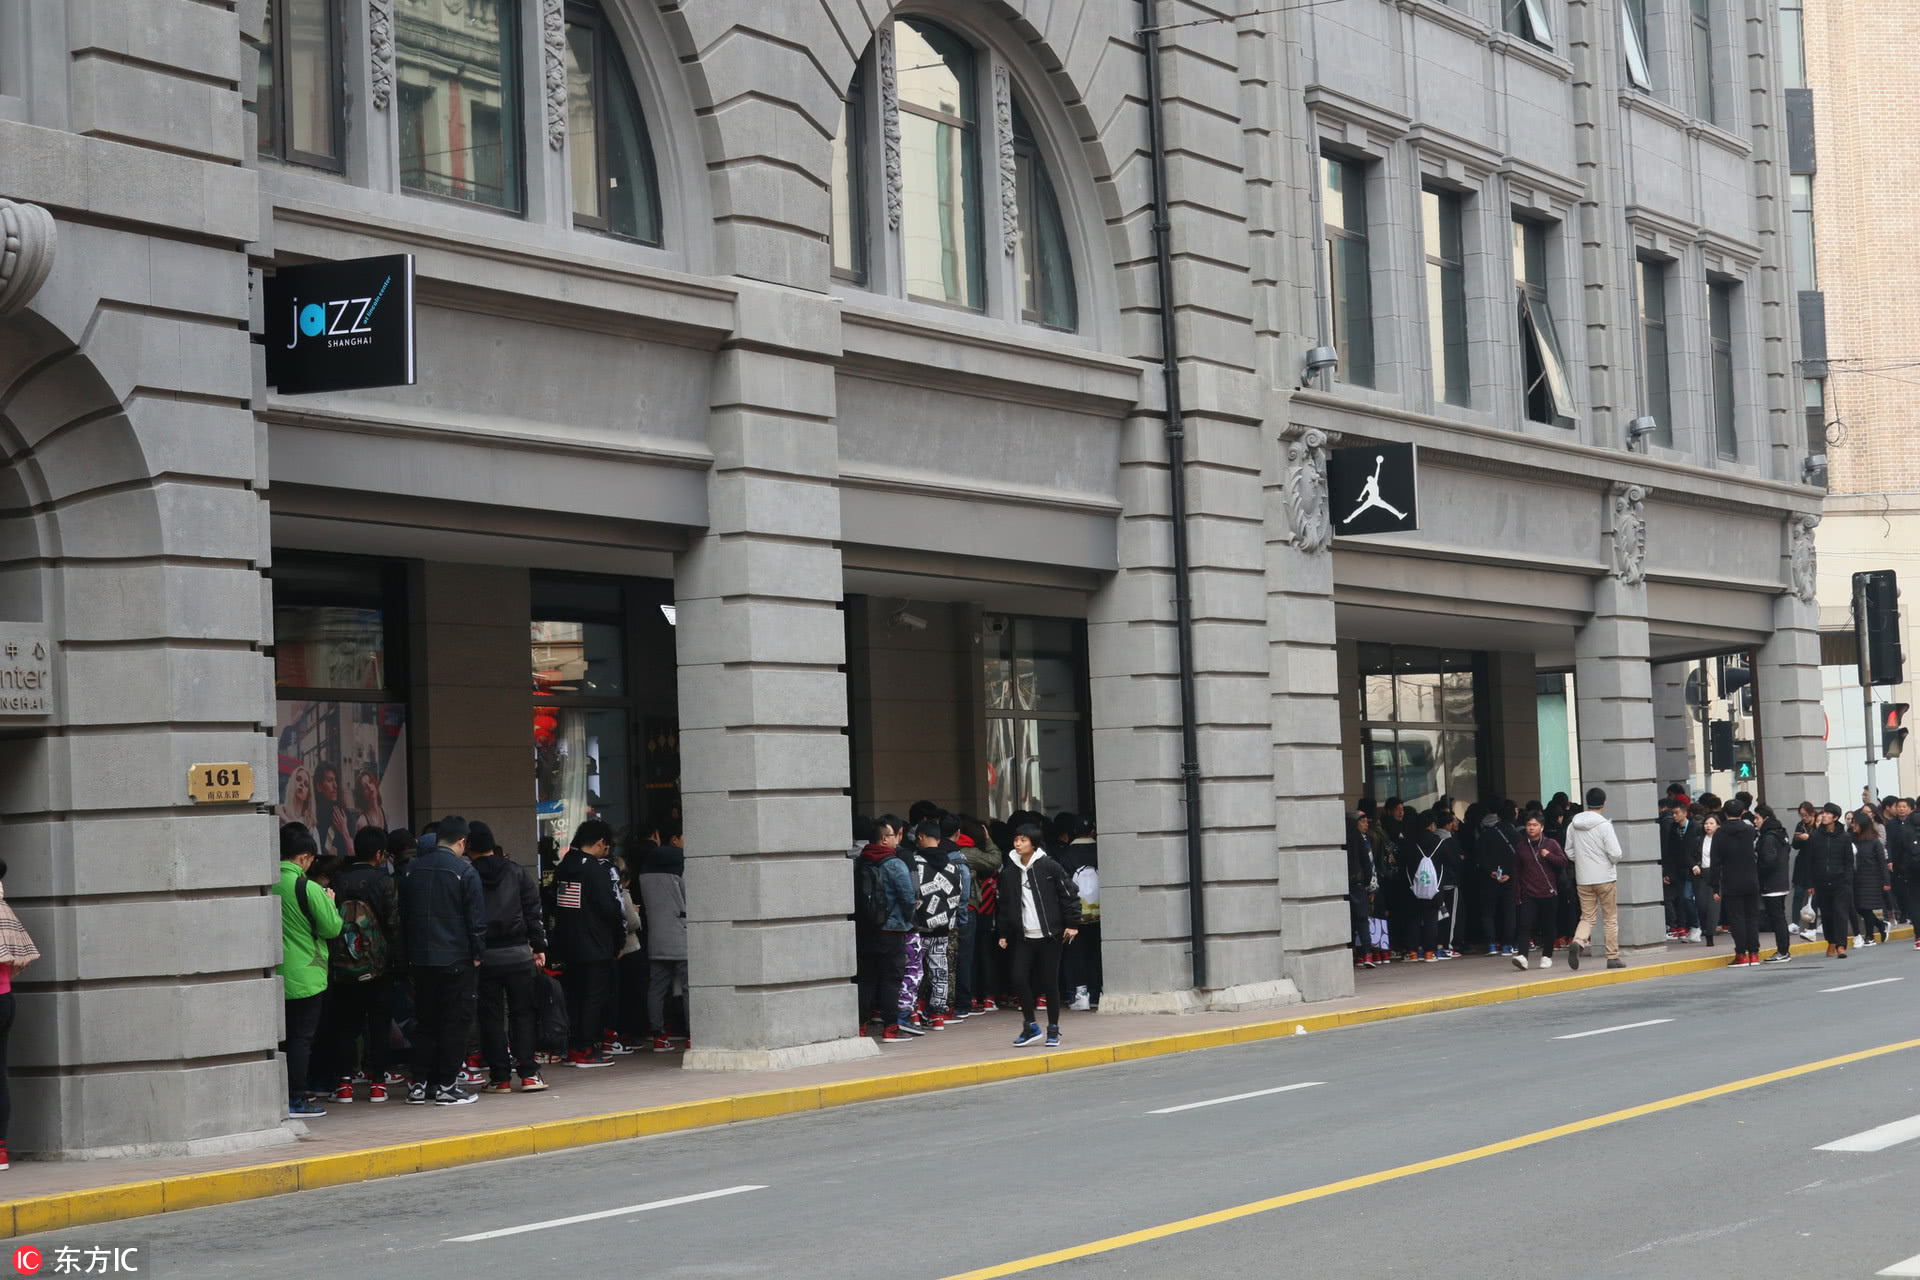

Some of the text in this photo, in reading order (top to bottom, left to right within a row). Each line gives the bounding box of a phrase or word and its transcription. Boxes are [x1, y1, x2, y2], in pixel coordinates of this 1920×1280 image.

[287, 297, 371, 349] jazz
[327, 336, 371, 348] SHANGHAI
[205, 769, 241, 786] 161
[208, 790, 240, 800] 南京东路
